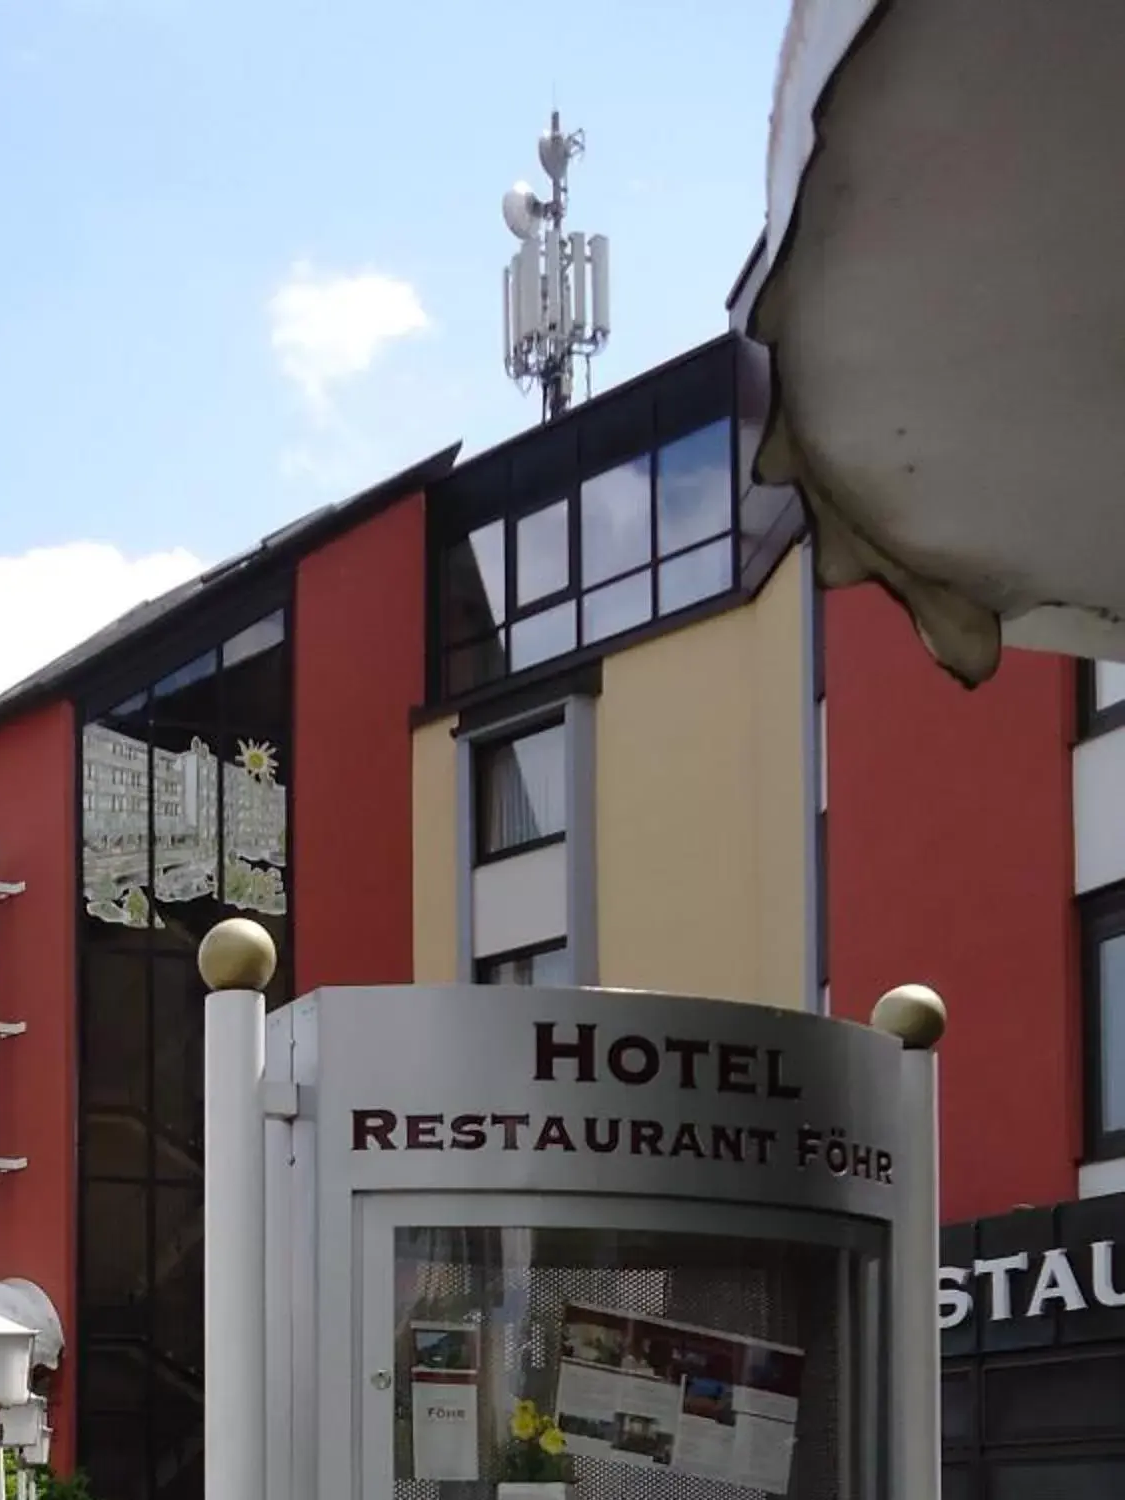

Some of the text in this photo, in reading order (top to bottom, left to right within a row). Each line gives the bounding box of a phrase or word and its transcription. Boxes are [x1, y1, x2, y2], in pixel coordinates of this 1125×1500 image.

[533, 1021, 803, 1100] HOTEL
[351, 1108, 894, 1185] RESTAURANT FÖHR
